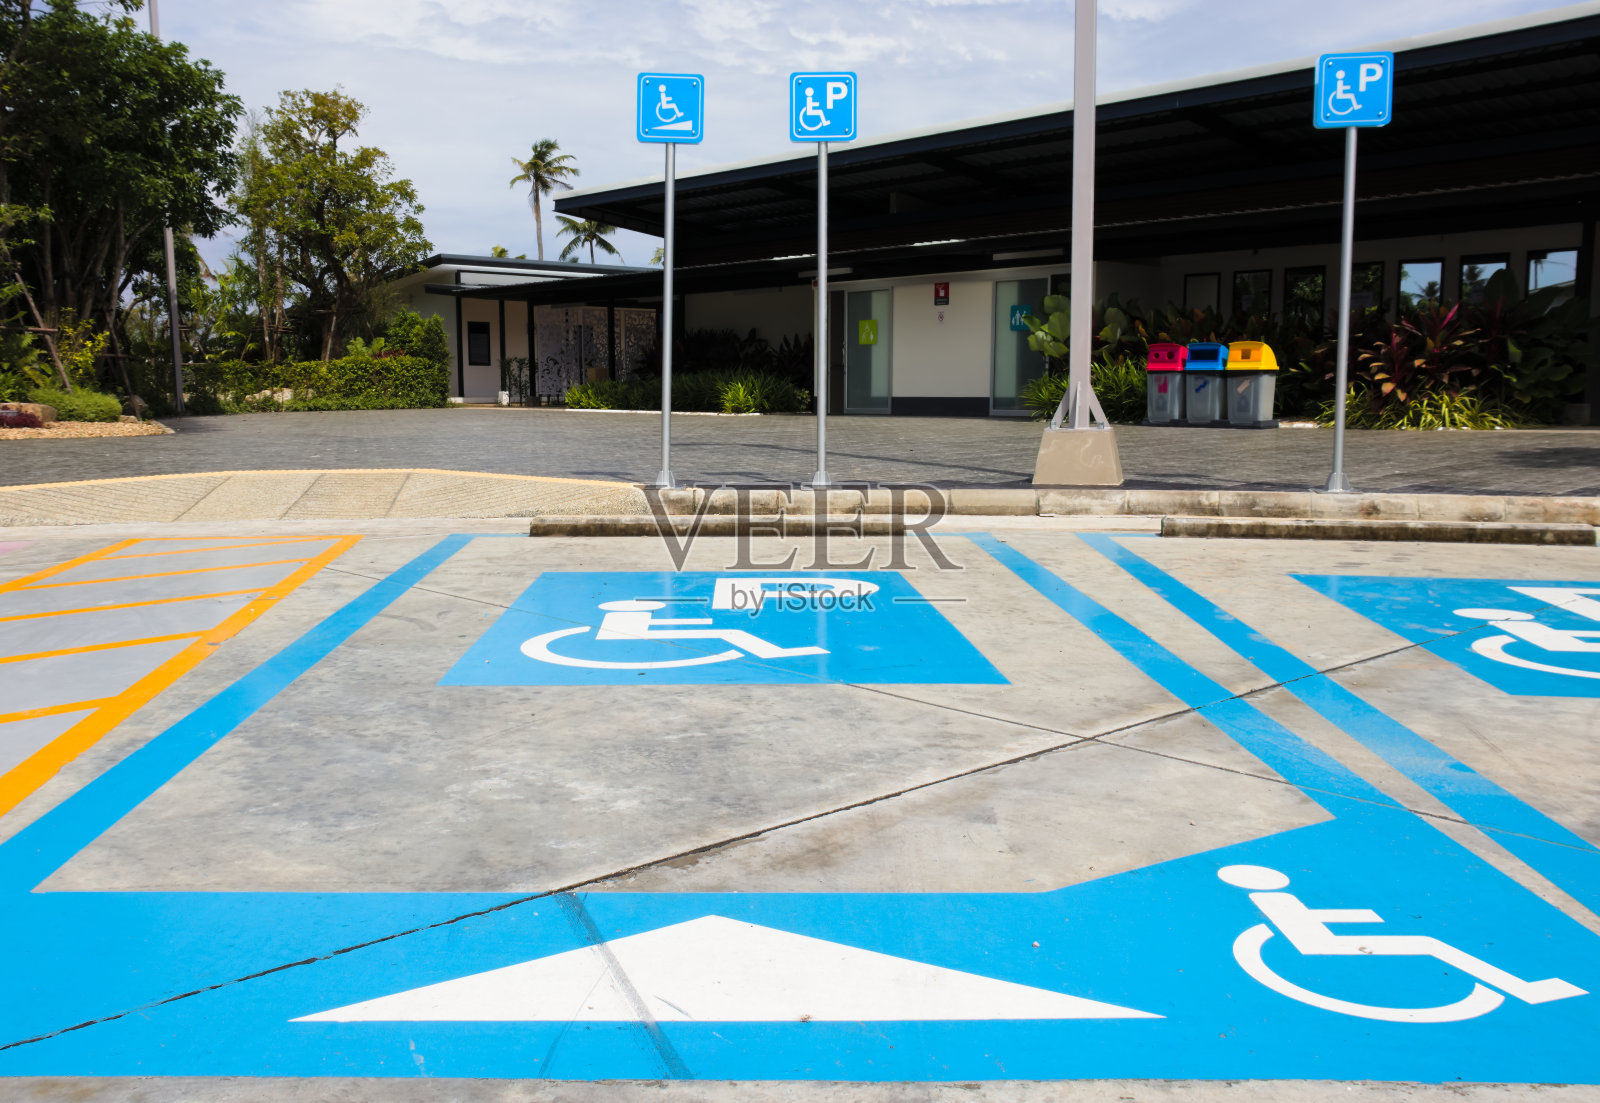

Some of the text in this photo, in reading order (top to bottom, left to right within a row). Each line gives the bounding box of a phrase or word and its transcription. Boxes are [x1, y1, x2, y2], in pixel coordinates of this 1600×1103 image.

[1359, 63, 1383, 92] P
[826, 82, 848, 109] P
[712, 577, 880, 609] P
